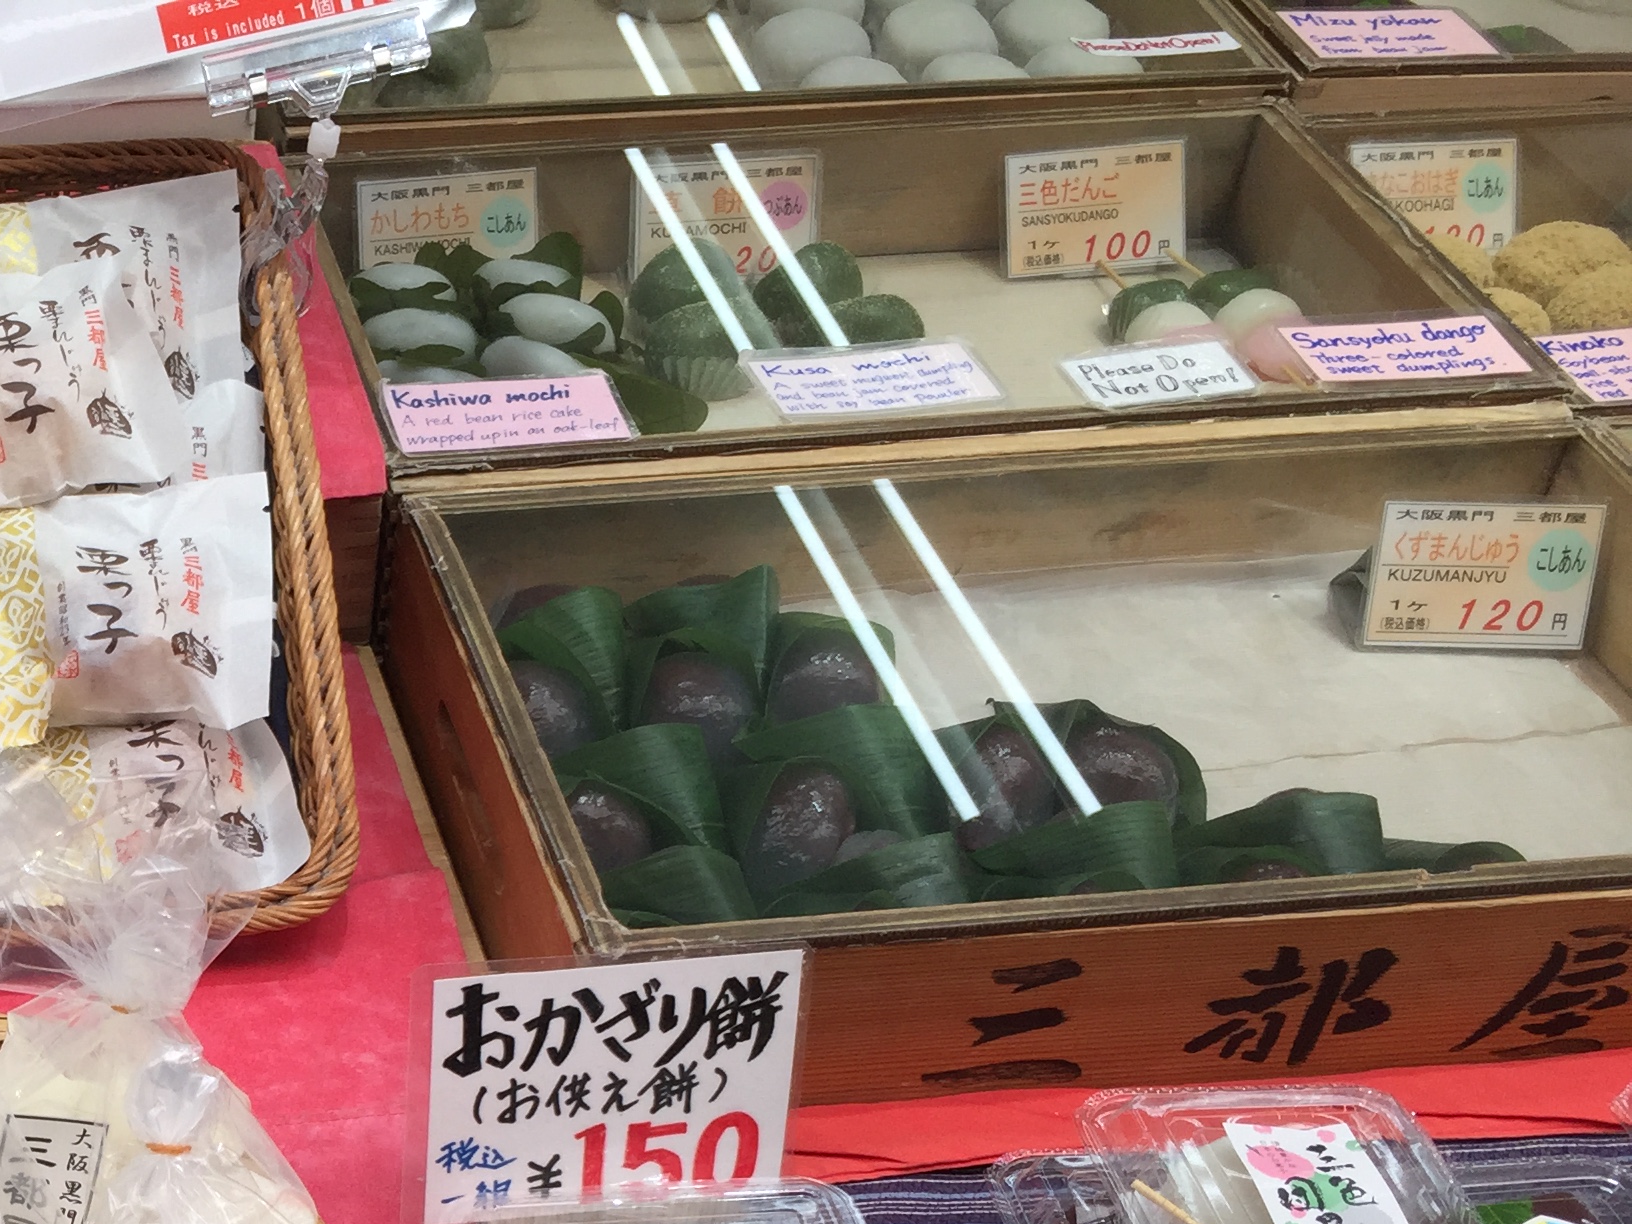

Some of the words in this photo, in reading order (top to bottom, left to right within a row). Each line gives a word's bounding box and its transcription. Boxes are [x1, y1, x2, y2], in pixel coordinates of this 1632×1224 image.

[172, 34, 196, 49] Tax
[204, 27, 218, 41] is
[225, 10, 285, 37] included
[1019, 158, 1098, 174] 大阪黒門
[1115, 152, 1172, 165] 三都屋
[1361, 150, 1434, 162] 大阪黒門
[1450, 148, 1502, 159] 三都屋
[371, 186, 450, 202] 大阪黒門
[466, 179, 524, 193] 三都屋
[1019, 173, 1119, 206] 三色だんご
[1468, 177, 1503, 199] こしあん
[370, 202, 469, 234] かしわもち
[487, 214, 526, 233] こしあん
[651, 222, 747, 238] KUAMOCHI
[1021, 208, 1119, 227] SANSYOKUDANGO
[1085, 230, 1151, 262] 100
[170, 266, 185, 330] 三都屋
[84, 309, 108, 371] 三都屋
[1291, 328, 1415, 350] Sansyoku
[1421, 322, 1487, 343] dango
[1537, 336, 1624, 356] Kinako
[761, 364, 832, 377] Kusa
[853, 351, 931, 372] mochi
[1387, 346, 1465, 361] colored
[1078, 364, 1155, 382] Please
[1156, 354, 1196, 371] Do
[1327, 364, 1386, 375] sweet
[774, 382, 790, 390] A
[803, 378, 847, 389] sweet
[776, 392, 802, 401] and
[812, 389, 849, 400] bean
[893, 378, 955, 393] covered
[1092, 380, 1149, 398] Not
[1156, 367, 1239, 394] Open!
[391, 390, 492, 409] Kashiwa
[506, 384, 570, 403] mochi
[786, 402, 828, 412] with
[402, 415, 415, 427] A
[425, 415, 453, 425] red
[465, 412, 502, 424] bean
[512, 408, 543, 420] rice
[550, 405, 582, 418] cake
[192, 426, 207, 457] 黒門
[407, 433, 474, 447] wrapped
[528, 426, 545, 435] an
[1396, 510, 1494, 522] 大阪黒門
[1513, 512, 1587, 524] 三都屋
[1394, 531, 1520, 563] くずまんじゅう
[1536, 546, 1586, 573] こしあん
[180, 556, 205, 615] 三都屋
[1388, 568, 1507, 583] KUZUMANJYU
[75, 546, 138, 654] 栗っ子
[1458, 599, 1544, 631] 120
[1551, 613, 1567, 630] 円
[442, 970, 790, 1077] おかざり餅
[435, 1137, 518, 1173] 税込
